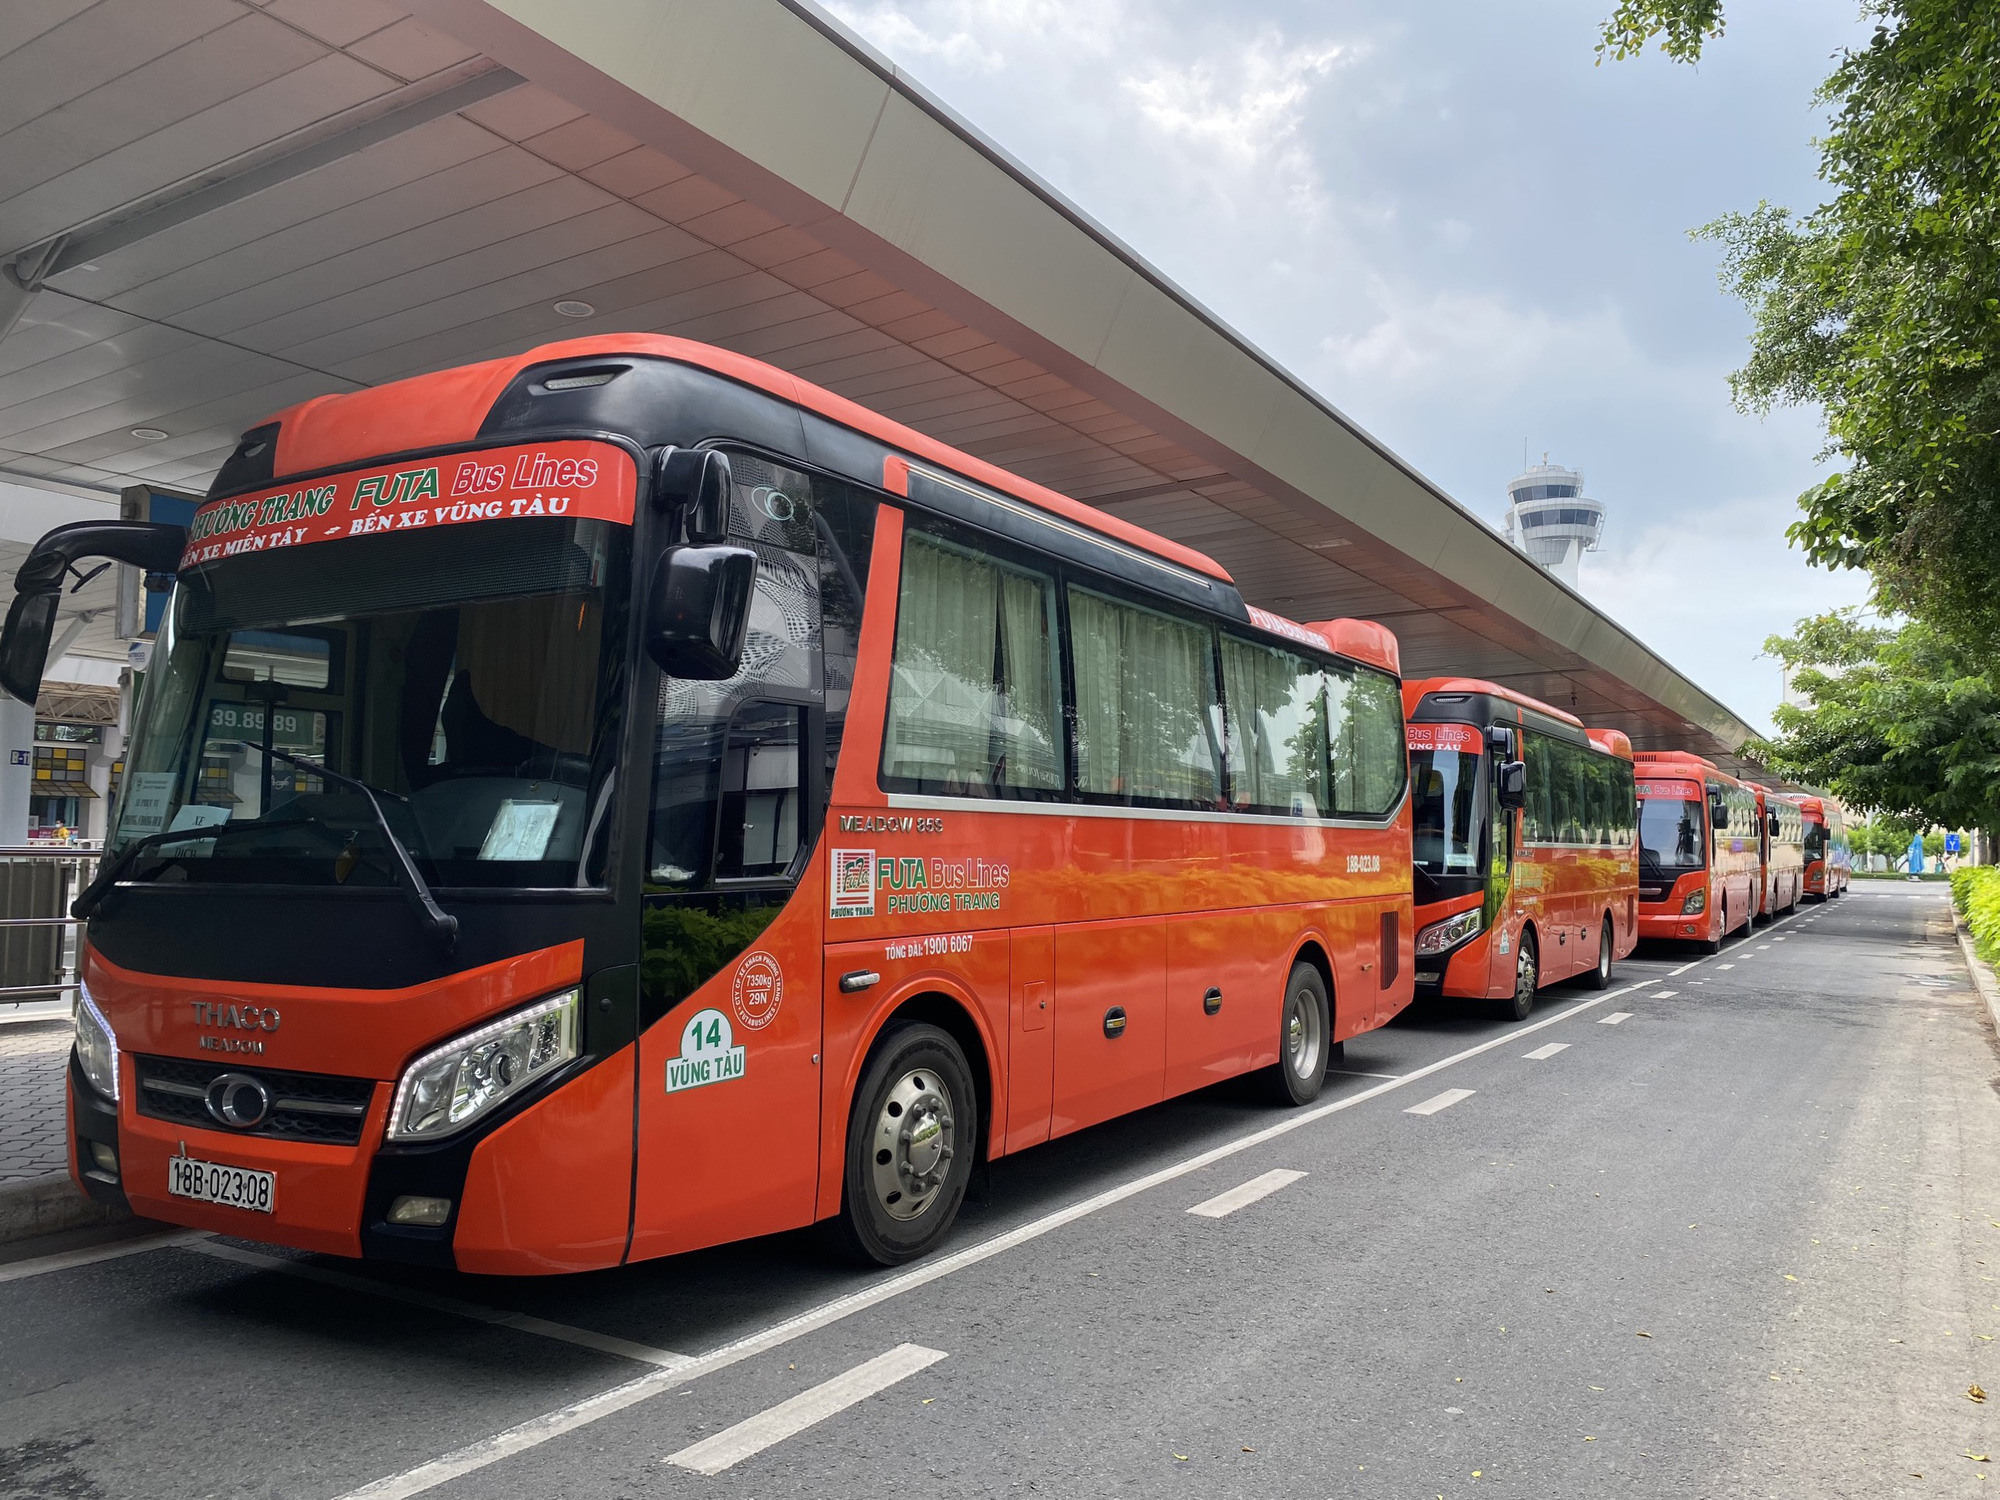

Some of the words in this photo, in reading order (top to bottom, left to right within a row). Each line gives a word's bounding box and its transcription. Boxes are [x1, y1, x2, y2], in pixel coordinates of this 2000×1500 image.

[257, 485, 336, 526] TRANG
[350, 467, 439, 511] FUTA
[450, 462, 506, 496] Bus
[510, 453, 598, 489] Lines
[200, 544, 221, 561] XE
[222, 530, 267, 556] MIỀN
[269, 526, 308, 547] TÂY
[349, 508, 395, 535] BẾN
[396, 510, 428, 528] XE
[434, 500, 503, 523] VŨNG
[510, 493, 570, 515] TÀU
[1407, 727, 1431, 740] Bus
[1435, 727, 1471, 742] Lines
[1408, 742, 1433, 750] ŨNG
[1436, 742, 1462, 750] TÀU
[1655, 785, 1670, 795] Bus
[1672, 785, 1693, 796] Lines
[840, 815, 913, 832] MEADOW
[916, 818, 944, 833] 85S
[877, 857, 927, 890] FUTA
[930, 858, 964, 889] Bus
[966, 858, 1010, 888] Lines
[855, 907, 873, 916] TRANG
[888, 892, 950, 914] PHƯƠNG
[954, 893, 1000, 910] TRANG
[885, 941, 906, 960] TỔNG
[923, 937, 948, 955] 1900
[950, 935, 973, 953] 6067
[746, 974, 772, 988] 7350kg
[749, 992, 767, 1005] 29N
[191, 1002, 280, 1031] THACO
[200, 1036, 265, 1055] MEADOW
[691, 1018, 721, 1051] 14
[670, 1058, 710, 1088] VŨNG
[714, 1050, 743, 1078] TÀU
[173, 1161, 270, 1207] 18B-023.08
